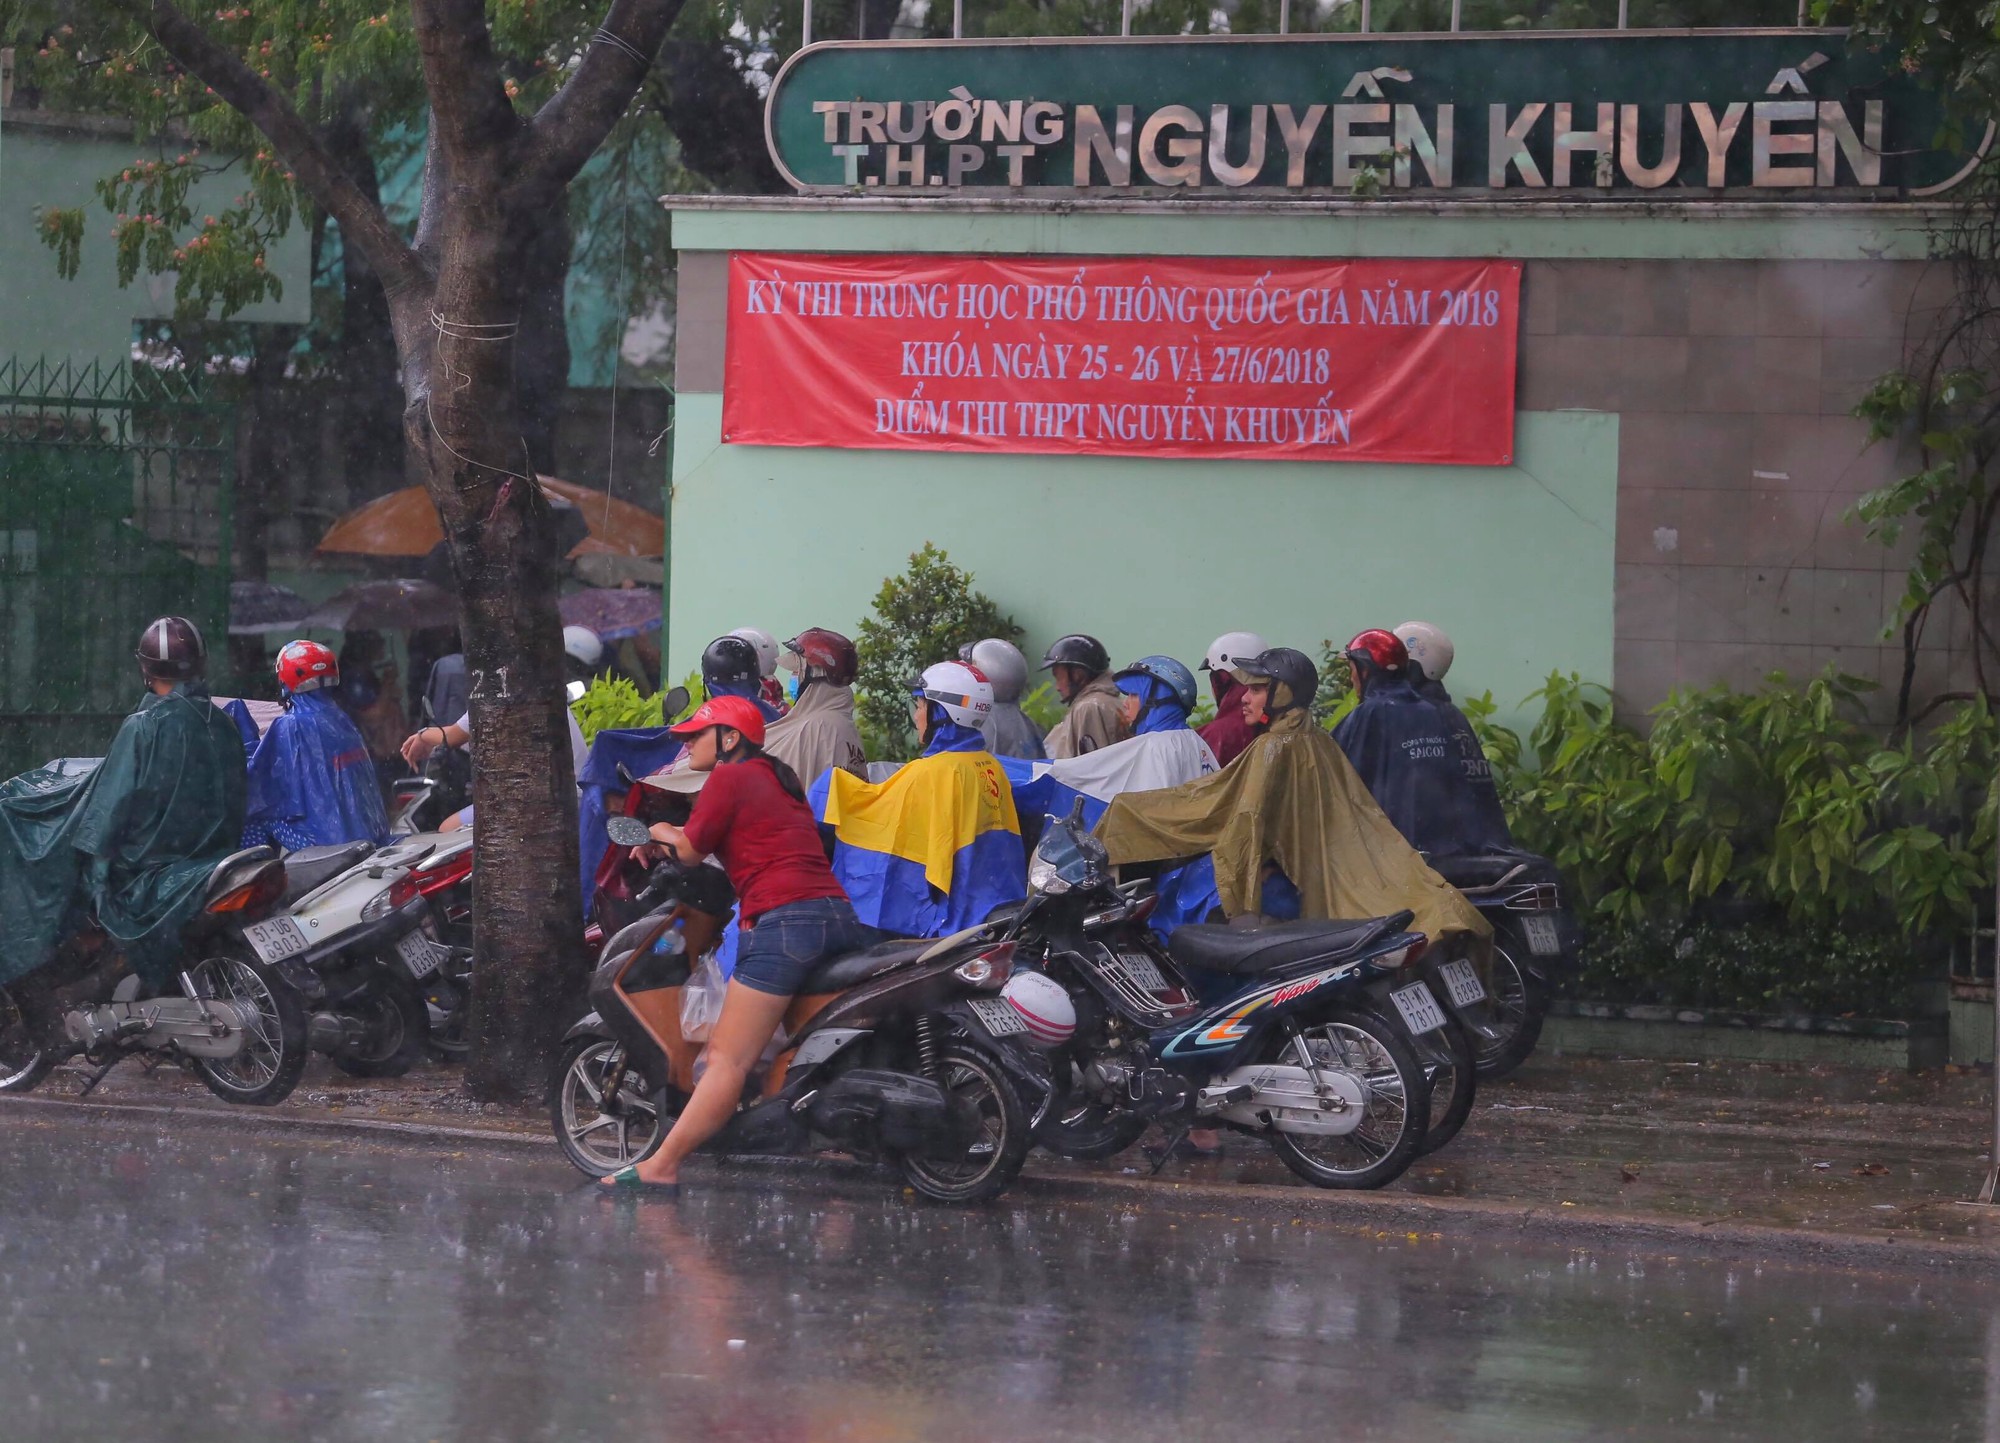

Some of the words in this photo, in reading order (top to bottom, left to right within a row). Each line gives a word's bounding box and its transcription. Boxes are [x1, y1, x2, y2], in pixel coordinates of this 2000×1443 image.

[813, 85, 1064, 144] TRƯỜNG
[1073, 67, 1454, 187] NGUYỄN
[1488, 52, 1883, 188] KHUYẾN
[746, 270, 786, 314] KỲ
[794, 281, 843, 317] THI
[851, 282, 949, 319] TRUNG
[955, 283, 1018, 329] HỌC
[1025, 267, 1087, 321] PHỔ
[1095, 275, 1197, 322] THÔNG
[1205, 271, 1290, 331] QUỐC
[1297, 287, 1350, 325] GIA
[1359, 279, 1432, 326] NĂM
[1439, 289, 1499, 327] 2018
[901, 331, 983, 378] KHÓA
[991, 332, 1073, 379] NGÀY
[1079, 345, 1109, 380] 25
[1115, 363, 1123, 372] -
[1130, 346, 1160, 381] 26
[1168, 336, 1204, 382] VÀ
[1210, 347, 1330, 384] 27/6/2018
[875, 381, 951, 435] ĐIỂM
[957, 401, 1008, 437] THI
[1014, 402, 1090, 439] THPT
[1098, 387, 1215, 442] NGUYỄN
[1224, 390, 1353, 445] KHUYẾN
[469, 666, 510, 699] 21
[252, 918, 291, 943] 51-U6
[264, 934, 302, 959] 6903
[412, 950, 436, 974] 0358
[1445, 960, 1472, 984] 71-K5
[1273, 978, 1321, 1007] Wave
[1455, 979, 1481, 1003] 6899
[986, 1015, 1027, 1034] 126.31
[1409, 1005, 1438, 1031] 7817
